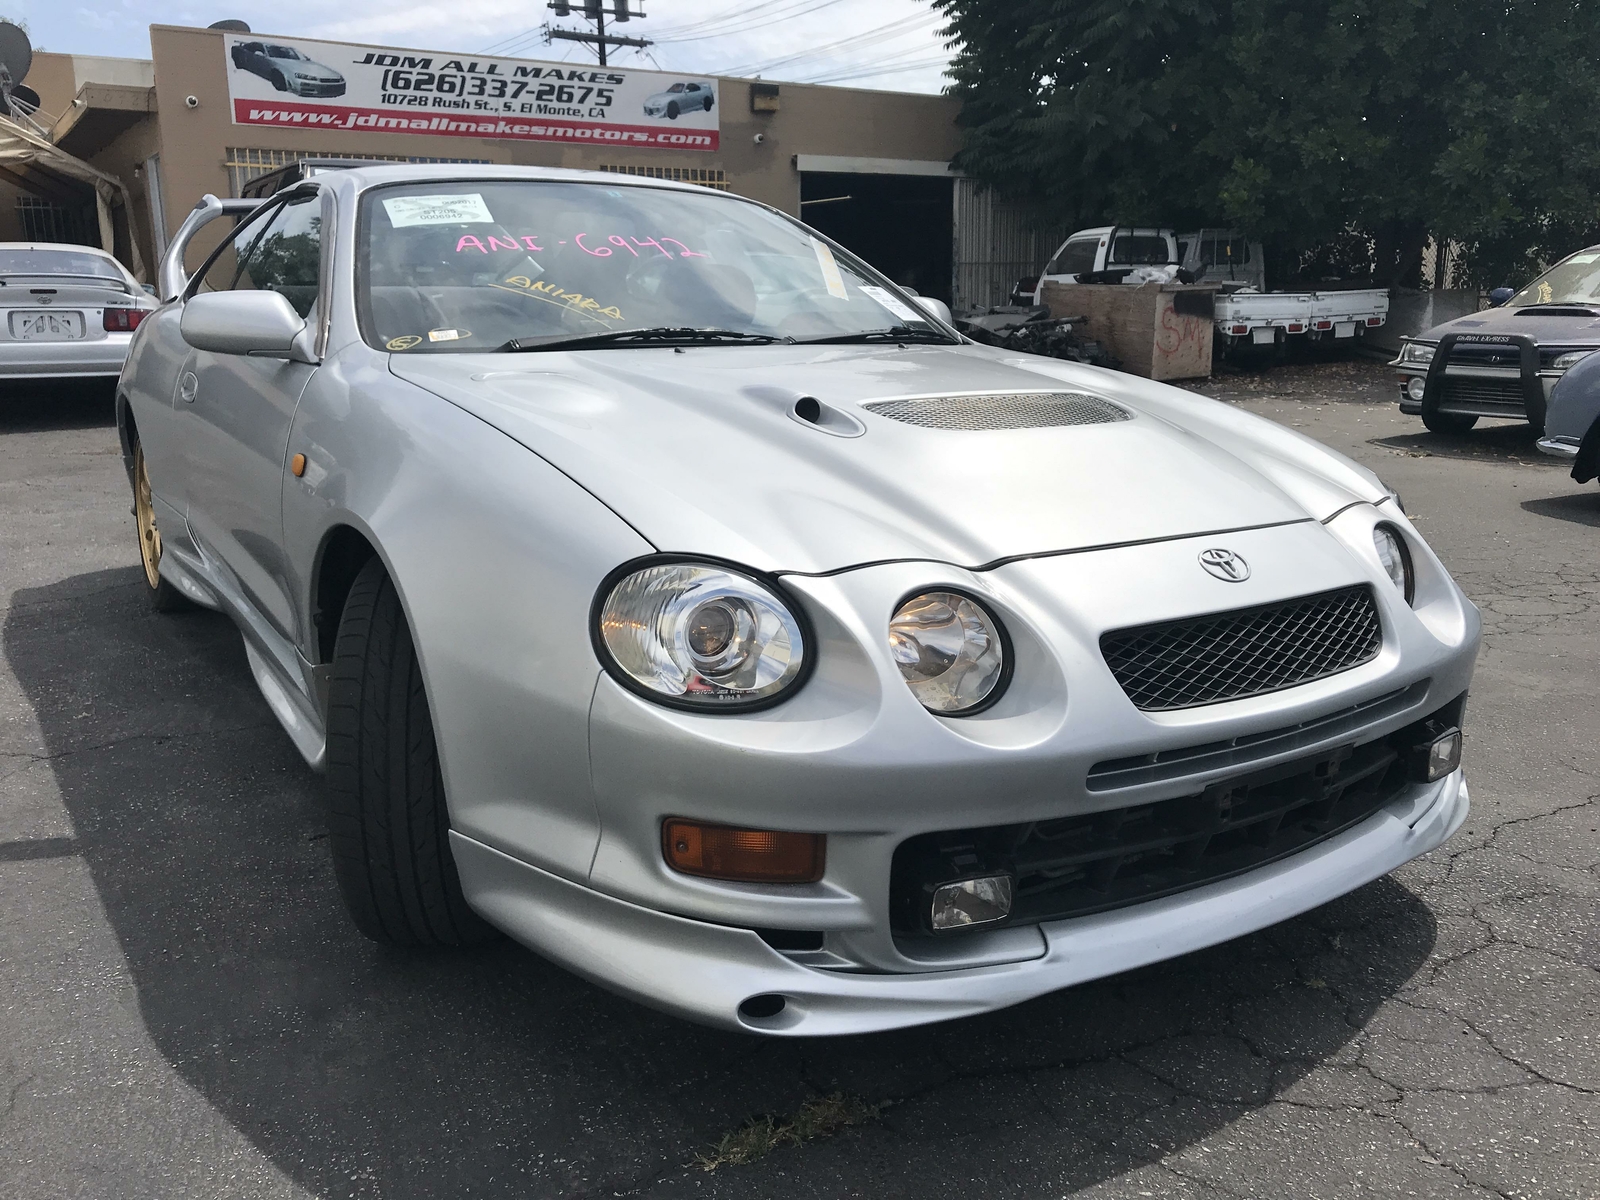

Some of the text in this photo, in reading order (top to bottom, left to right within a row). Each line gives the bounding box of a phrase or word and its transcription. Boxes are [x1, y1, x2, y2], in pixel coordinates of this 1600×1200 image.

[353, 53, 625, 85] JDM ALL MAKES
[381, 68, 615, 107] (626)337-2675
[381, 93, 428, 107] 10728
[432, 96, 470, 109] Rush
[502, 101, 516, 112] S.
[520, 103, 532, 113] El
[535, 104, 585, 118] Monte,
[588, 107, 605, 118] CA
[249, 108, 711, 145] www.jdmallmakesmotors.com
